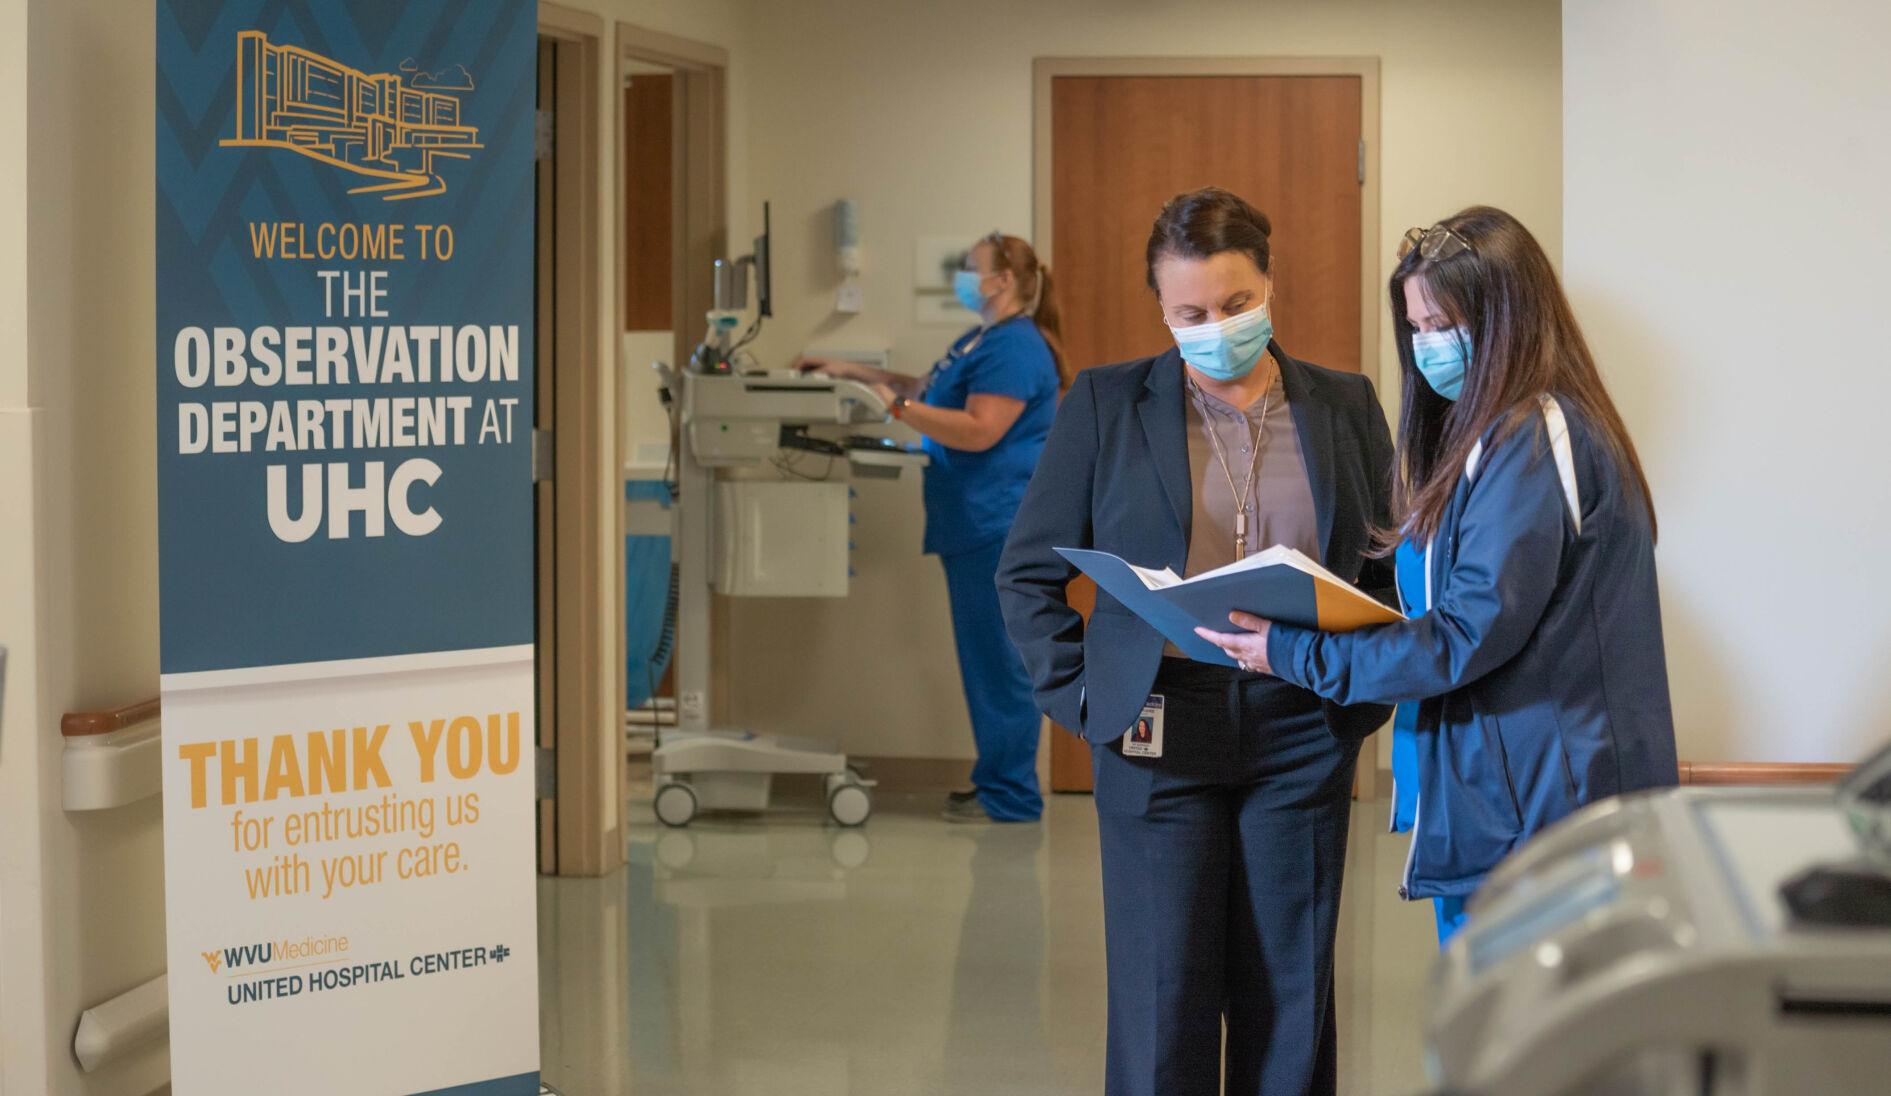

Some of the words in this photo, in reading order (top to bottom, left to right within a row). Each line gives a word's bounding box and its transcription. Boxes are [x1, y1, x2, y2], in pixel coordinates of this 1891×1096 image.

[250, 222, 405, 260] WELCOME
[414, 224, 455, 261] TO
[317, 271, 389, 318] THE
[174, 325, 519, 388] OBSERVATION
[178, 396, 472, 455] DEPARTMENT
[478, 398, 519, 445] AT
[266, 458, 443, 543] UHC
[178, 724, 393, 810] THANK
[408, 711, 520, 784] YOU
[231, 810, 275, 852] for
[284, 793, 435, 839] entrusting
[446, 792, 480, 827] us
[245, 853, 310, 900] with
[321, 850, 388, 900] your
[397, 841, 469, 881] care.
[228, 974, 303, 1005] UNITED
[309, 960, 405, 993] HOSPITAL
[410, 946, 487, 976] CENTER
